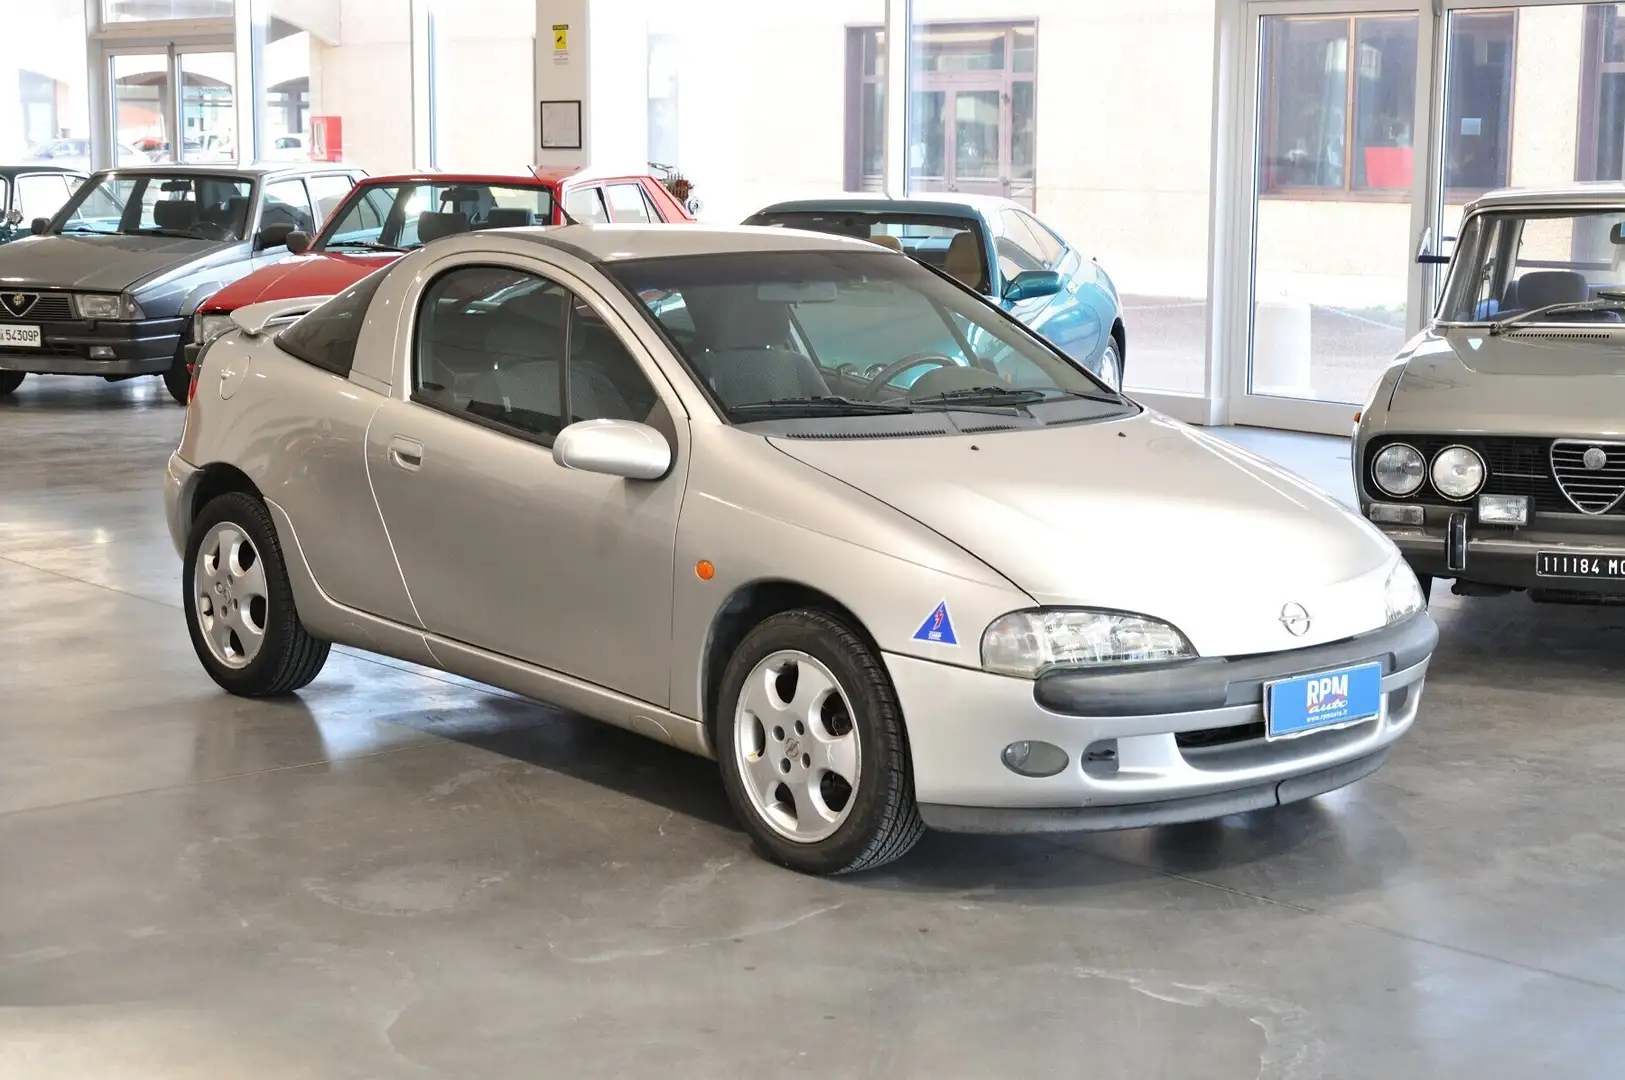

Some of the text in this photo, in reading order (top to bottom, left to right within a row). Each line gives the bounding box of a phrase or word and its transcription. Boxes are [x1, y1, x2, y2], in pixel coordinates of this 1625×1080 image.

[1544, 557, 1600, 575] 111184
[1306, 674, 1349, 708] RPM
[1308, 699, 1349, 714] auto
